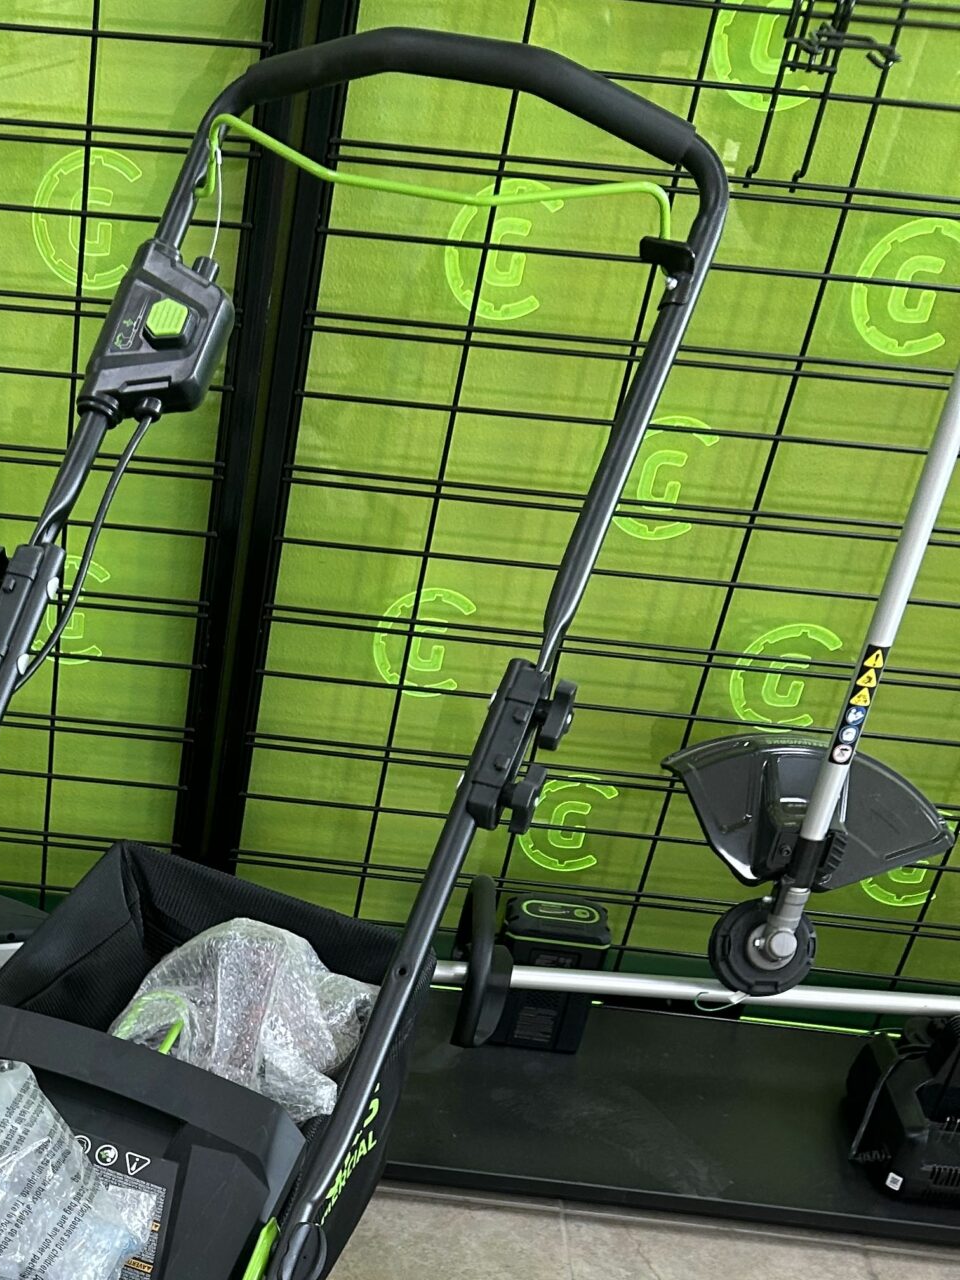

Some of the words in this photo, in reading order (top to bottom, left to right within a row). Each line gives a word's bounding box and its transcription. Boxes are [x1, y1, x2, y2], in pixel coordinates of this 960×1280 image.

[62, 1200, 79, 1215] bag
[55, 1213, 69, 1228] and
[62, 1215, 82, 1238] babies
[46, 1225, 61, 1240] any
[35, 1237, 53, 1255] other
[54, 1236, 68, 1250] and
[36, 1248, 61, 1274] children
